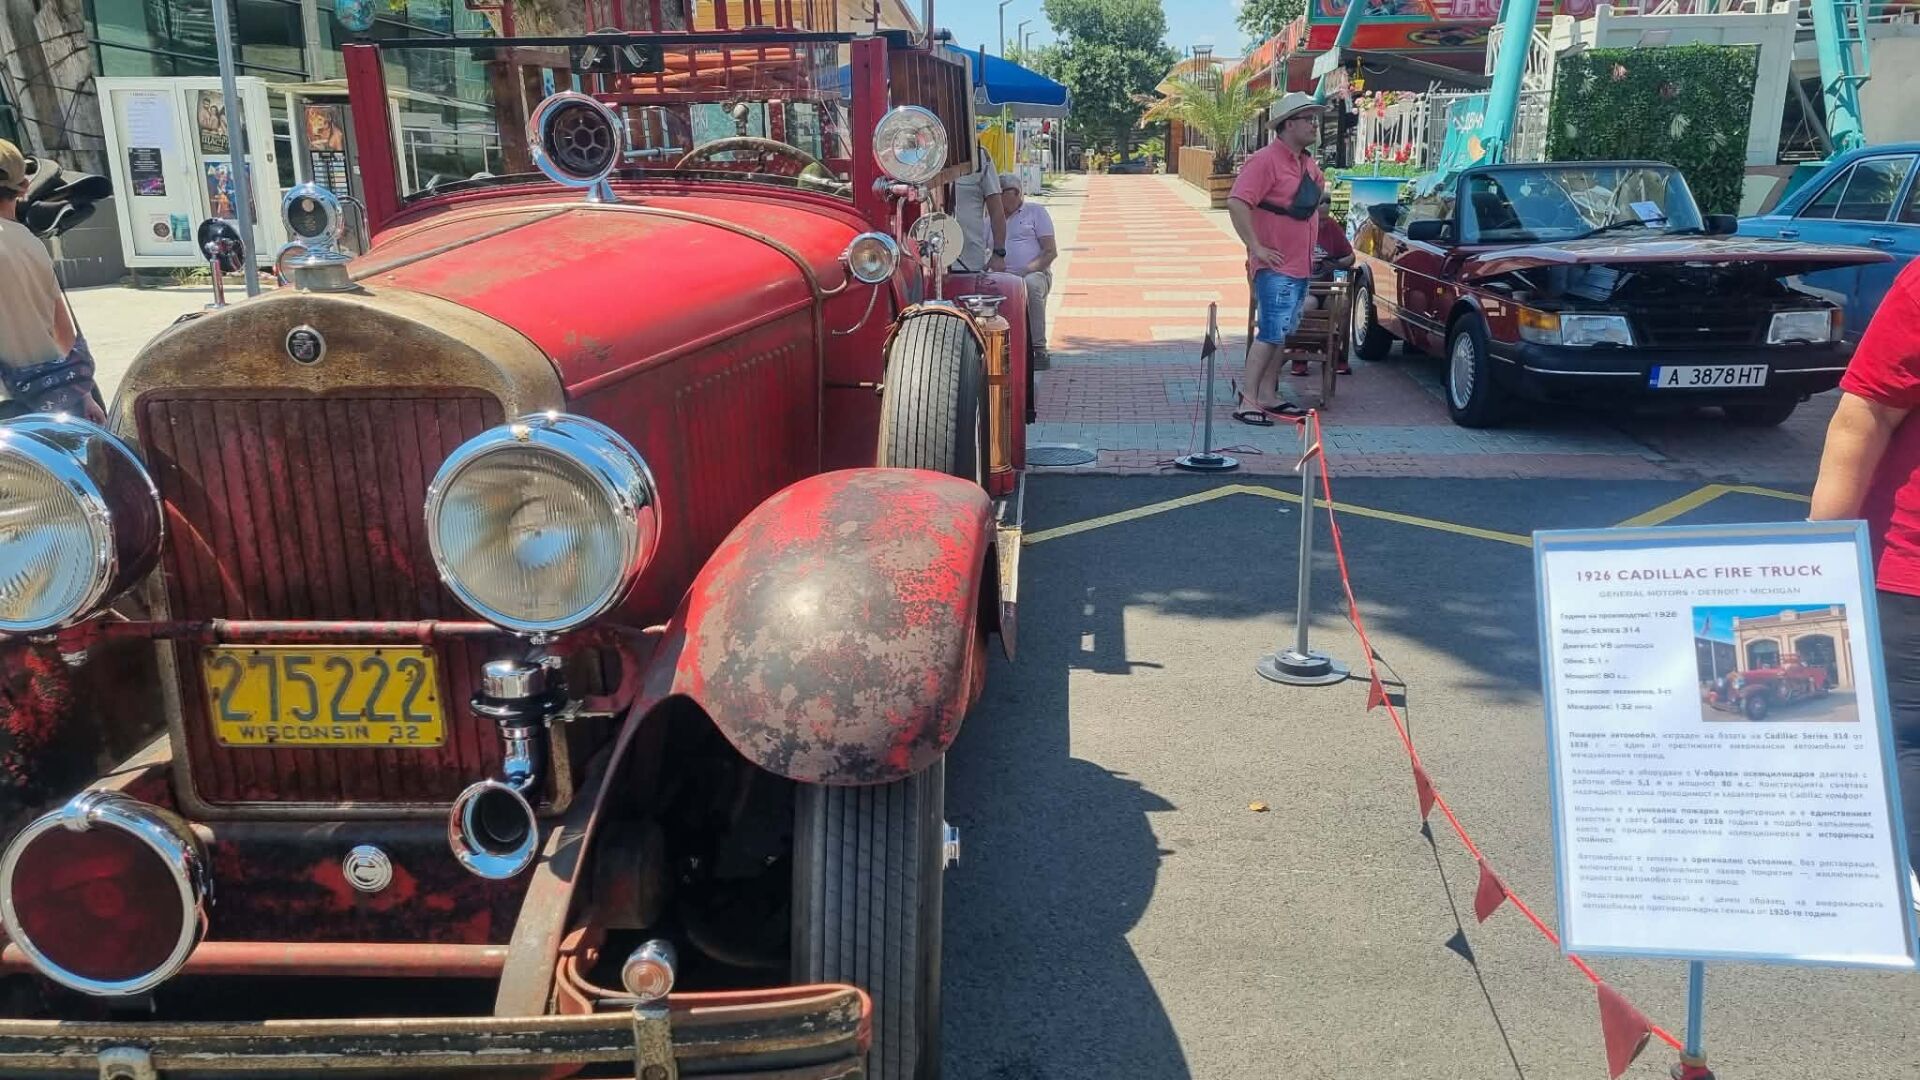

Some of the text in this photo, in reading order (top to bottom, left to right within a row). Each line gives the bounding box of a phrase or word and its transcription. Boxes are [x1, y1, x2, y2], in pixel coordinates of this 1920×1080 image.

[1668, 367, 1765, 385] A 3878 HT
[1576, 564, 1823, 581] 1926 CADILLAC FIRE TRUCK
[211, 655, 434, 722] 275222
[239, 726, 421, 739] WISCONSIN 32
[1764, 732, 1798, 740] Cadillac
[1801, 732, 1828, 740] Series
